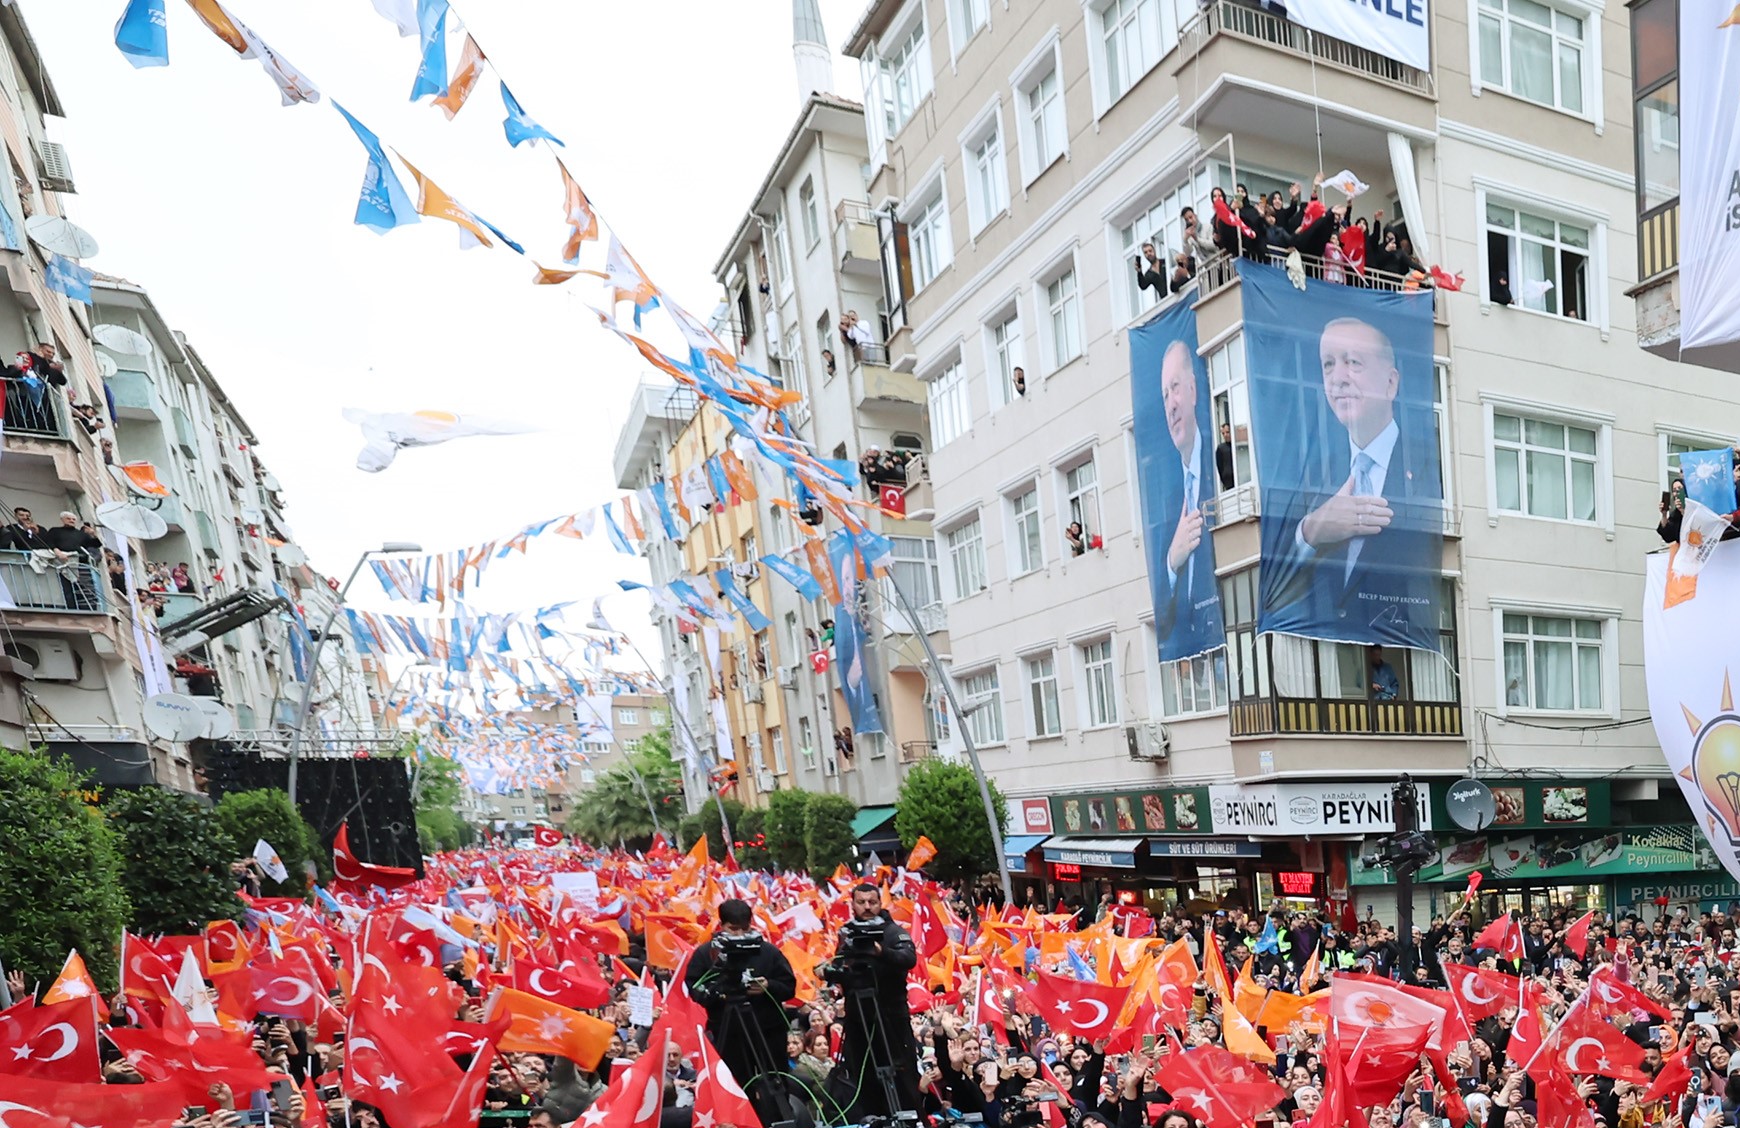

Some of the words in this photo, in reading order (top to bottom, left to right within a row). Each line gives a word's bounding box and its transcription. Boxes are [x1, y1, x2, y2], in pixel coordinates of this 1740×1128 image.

[156, 701, 191, 712] SUNNY
[1226, 794, 1278, 827] PEYNİRCİ
[1323, 793, 1427, 825] PEYNİİ
[1169, 843, 1182, 854] SÜT
[1182, 844, 1190, 854] VE
[1191, 843, 1204, 854] SÜT
[1632, 834, 1684, 848] Koçaklar
[1628, 851, 1690, 868] Peynircilik
